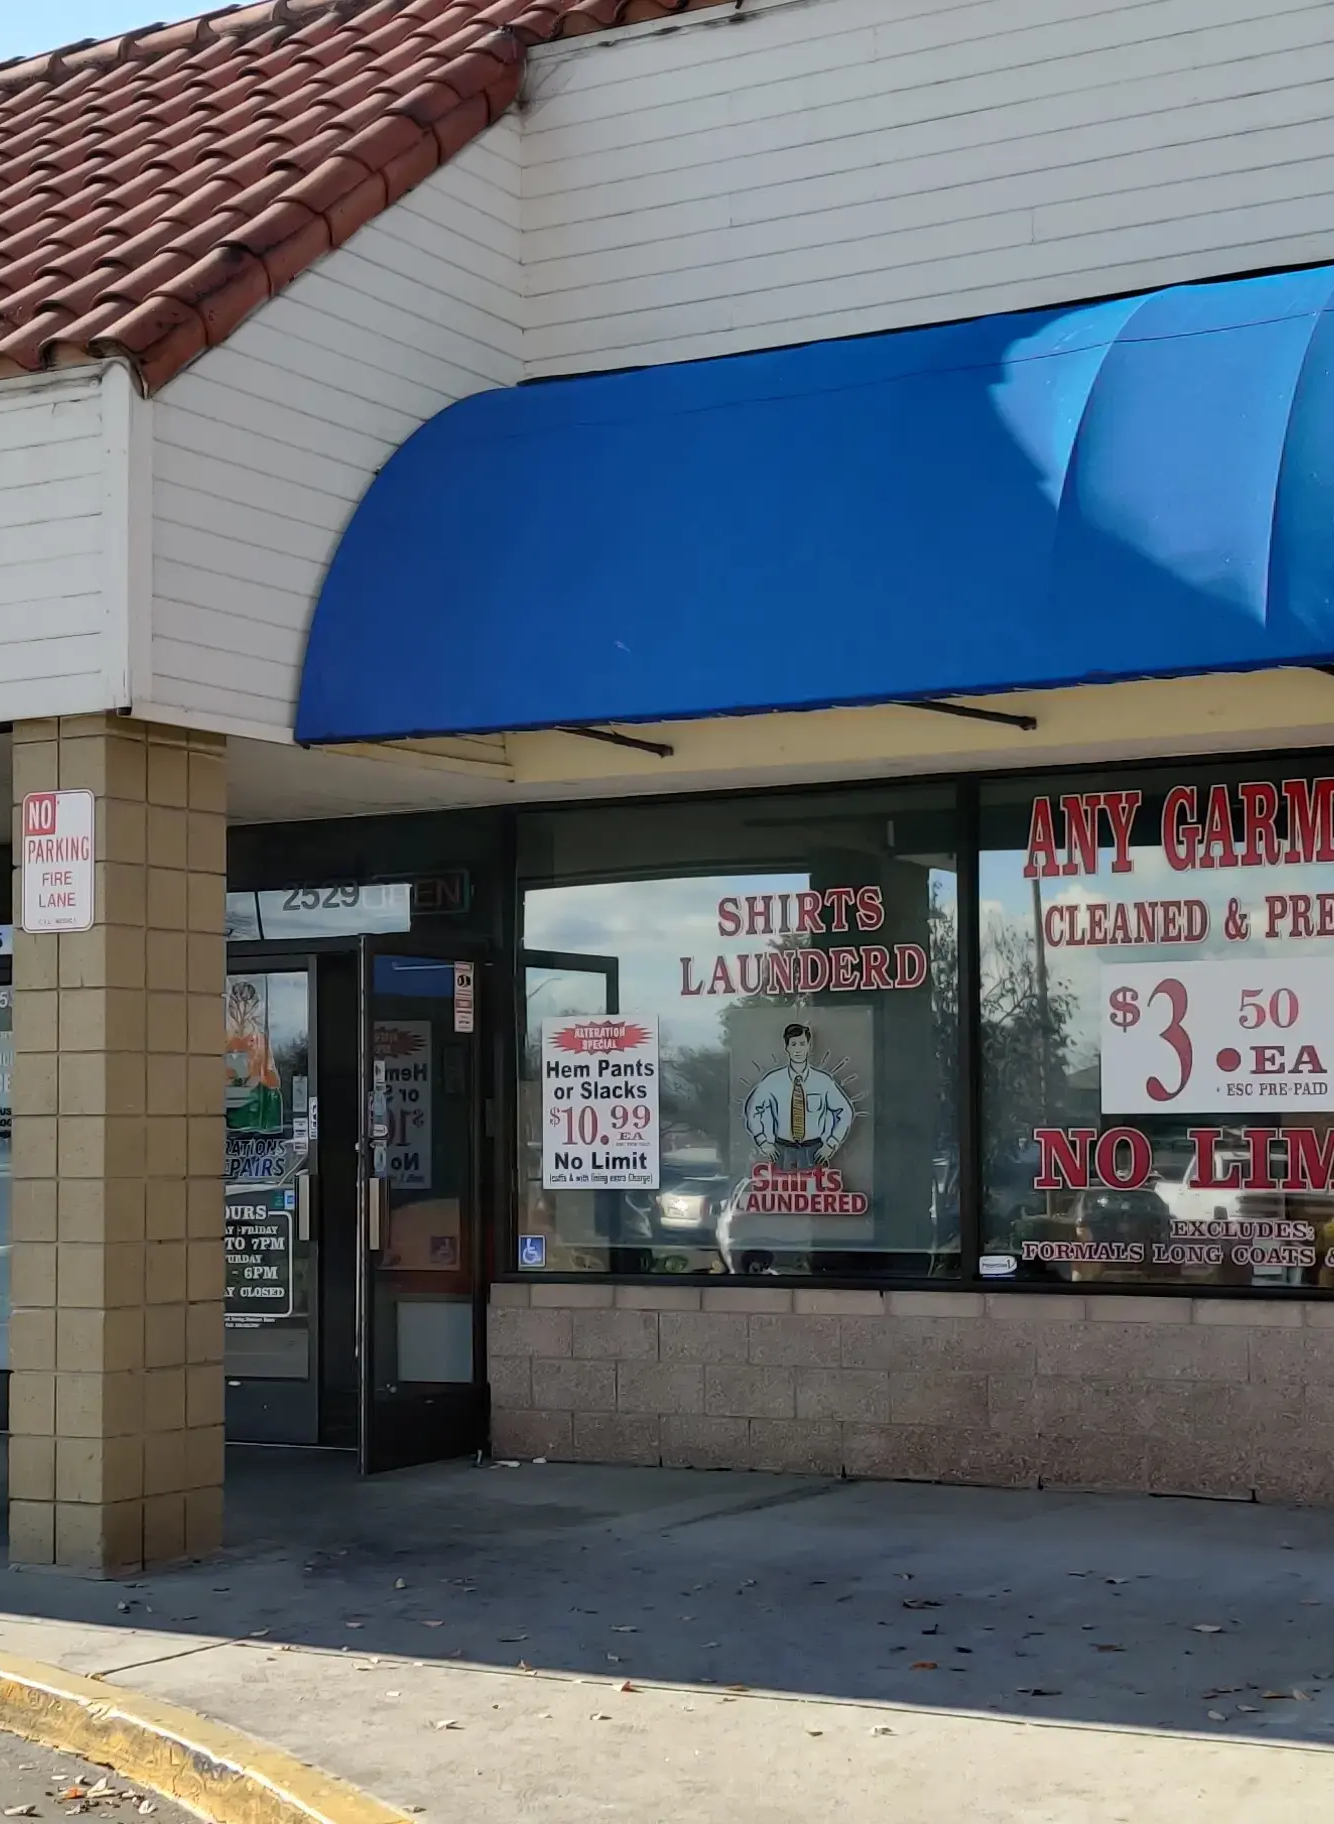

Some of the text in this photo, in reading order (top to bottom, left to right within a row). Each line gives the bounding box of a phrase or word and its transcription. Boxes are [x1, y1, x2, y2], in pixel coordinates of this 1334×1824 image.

[28, 800, 52, 831] NO
[1023, 790, 1142, 880] ANY
[28, 836, 90, 864] PARKING
[42, 871, 73, 887] FIRE
[39, 892, 77, 908] LANE
[283, 880, 360, 912] 2529
[717, 886, 884, 937] SHIRTS
[1044, 898, 1209, 948] CLEANED
[1224, 897, 1250, 941] &
[680, 943, 928, 996] LAUNDERD
[1238, 988, 1300, 1030] 50
[574, 1027, 627, 1039] ALTERATION
[582, 1038, 618, 1050] SPECIAL
[546, 1058, 655, 1079] Hem Pants
[554, 1081, 647, 1101] or Slacks
[1226, 1081, 1329, 1097] ESC PRE-PAID
[0, 1107, 11, 1116] US
[618, 1131, 645, 1141] EA
[554, 1151, 648, 1170] No Limit
[1034, 1127, 1154, 1193] NO
[752, 1162, 844, 1193] Shirts
[1171, 1219, 1316, 1241] EXCLUDES:
[251, 1237, 285, 1250] 7PM
[1022, 1240, 1144, 1263] FORMALS
[1153, 1243, 1224, 1265] LONG
[1231, 1244, 1316, 1266] COATS
[225, 1254, 264, 1264] URDAY
[244, 1266, 278, 1280] 6PM
[240, 1287, 285, 1298] CLOSED
